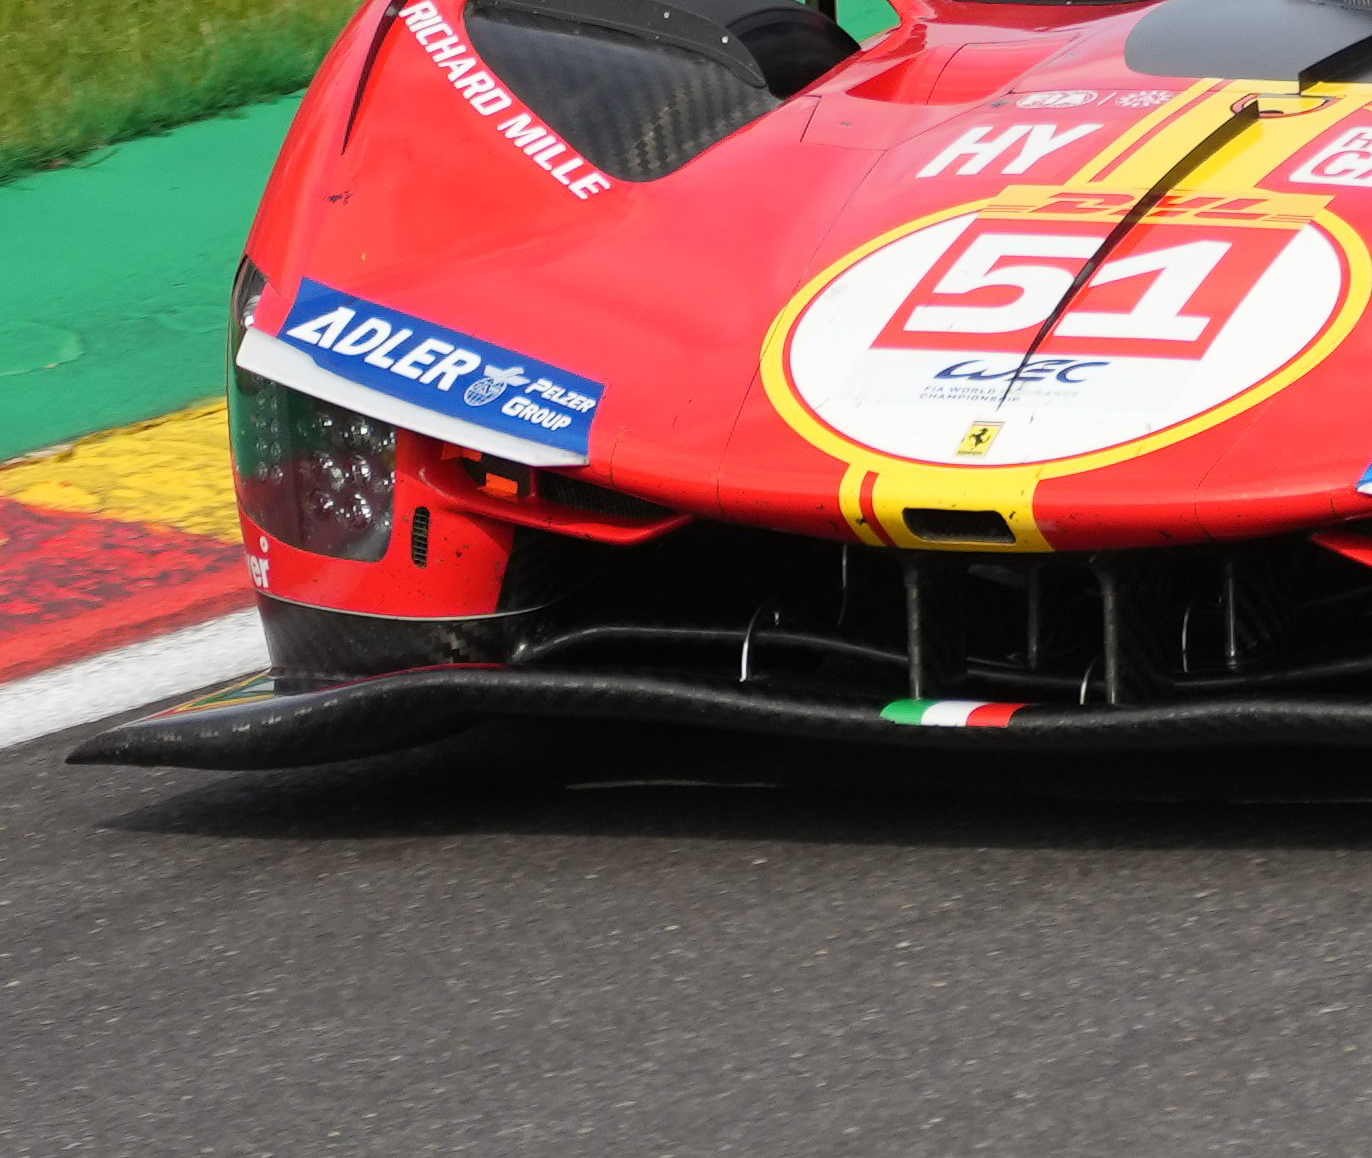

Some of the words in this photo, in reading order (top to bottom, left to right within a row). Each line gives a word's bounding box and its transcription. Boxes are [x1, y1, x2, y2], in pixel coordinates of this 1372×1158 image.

[398, 0, 513, 117] RICHARD
[496, 112, 612, 201] MILLE
[917, 123, 1105, 177] HY
[902, 233, 1233, 343] 51
[286, 306, 482, 391] ADLER
[934, 359, 1112, 384] WEC
[949, 386, 996, 394] WORLD
[501, 395, 572, 432] GROUP
[526, 377, 597, 413] PELZER
